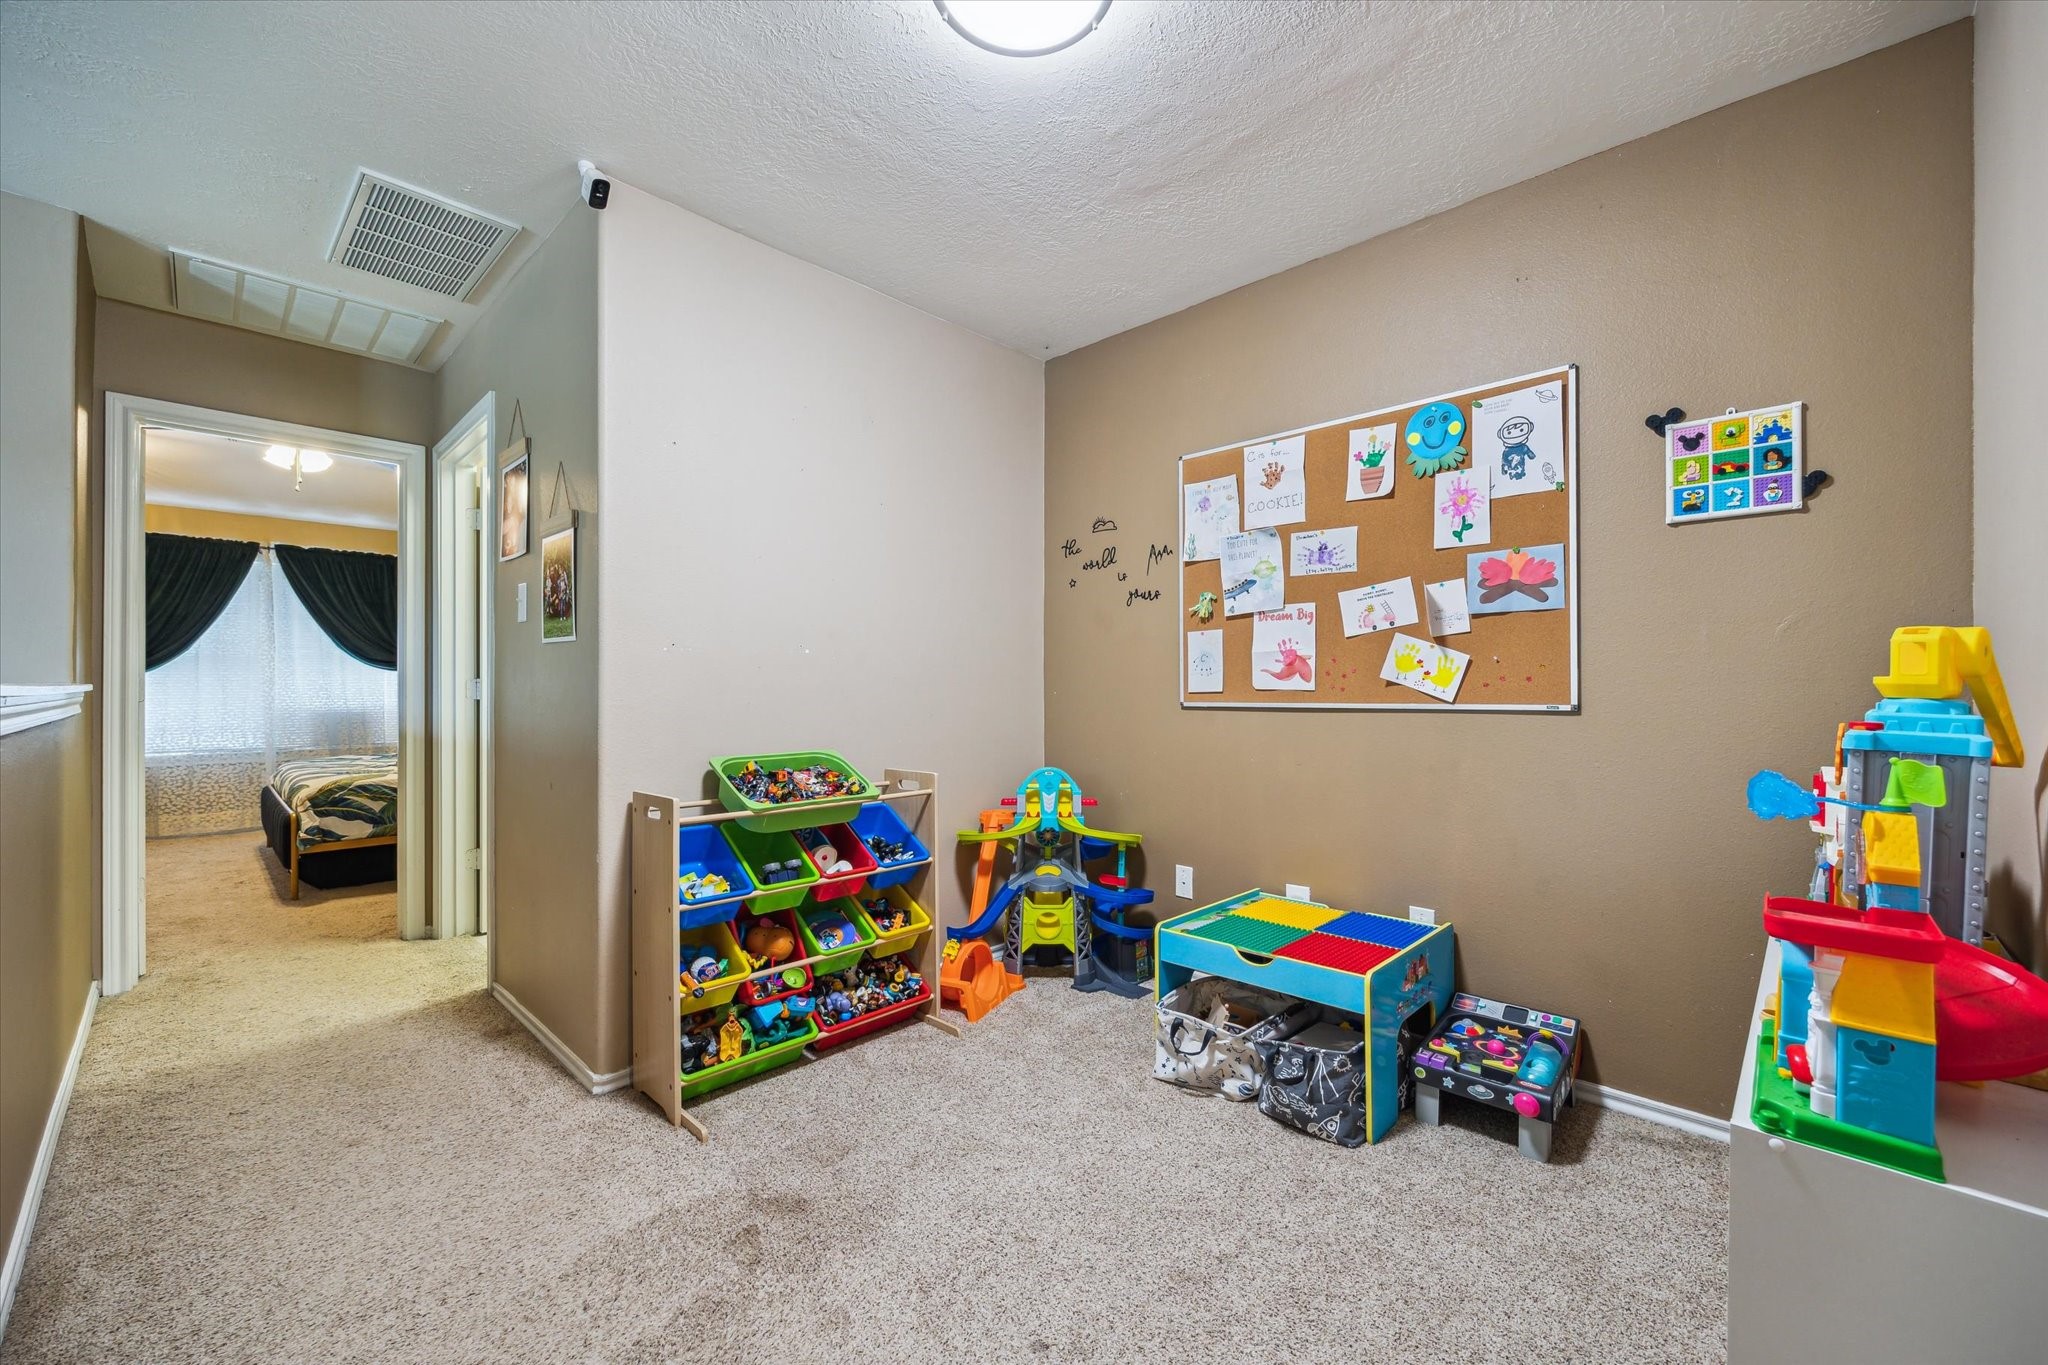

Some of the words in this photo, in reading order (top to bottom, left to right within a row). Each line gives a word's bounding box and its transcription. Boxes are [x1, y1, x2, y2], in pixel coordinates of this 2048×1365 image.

[1247, 451, 1256, 462] C
[1248, 492, 1303, 513] COOKIE!
[1061, 538, 1082, 558] the
[1082, 546, 1117, 570] world
[1117, 572, 1128, 582] is
[1126, 588, 1162, 607] yours
[1257, 610, 1293, 622] Dream
[1296, 607, 1314, 625] Big
